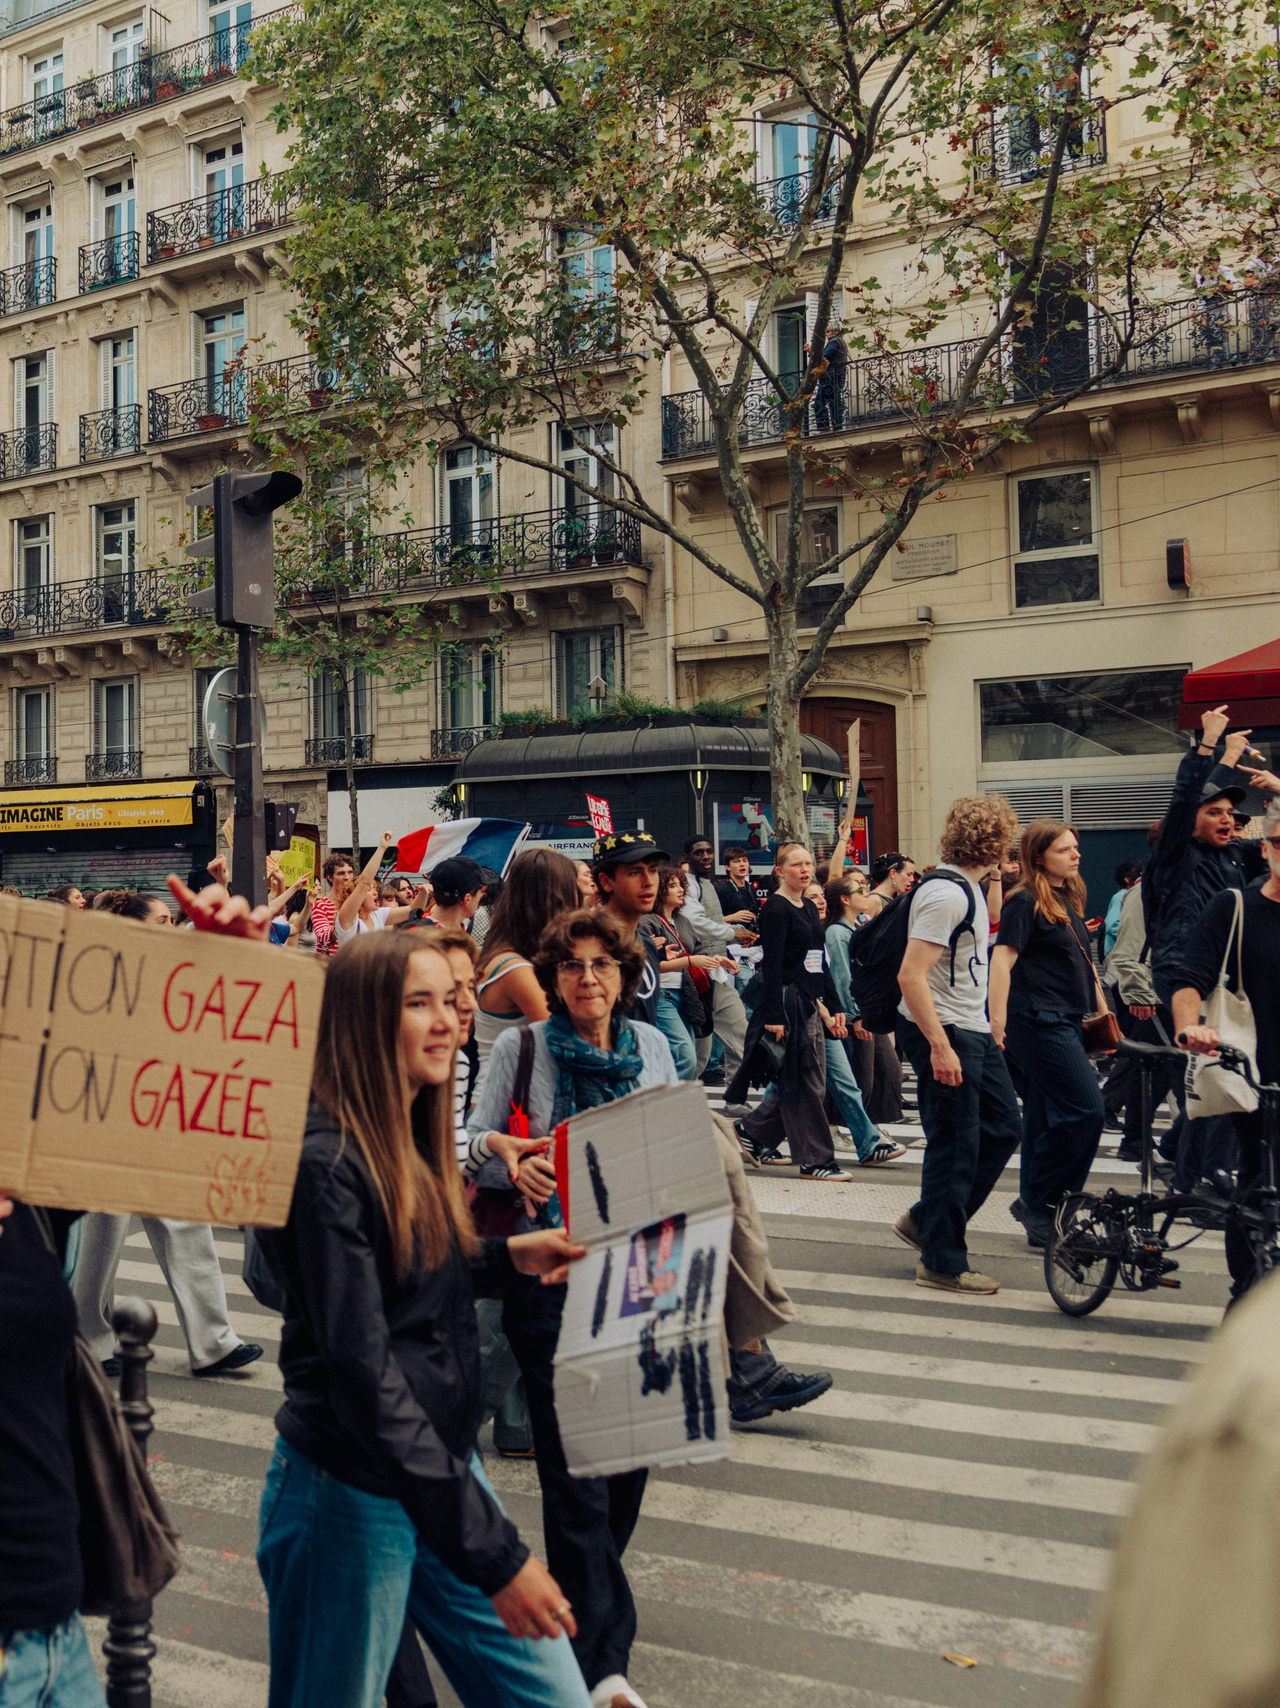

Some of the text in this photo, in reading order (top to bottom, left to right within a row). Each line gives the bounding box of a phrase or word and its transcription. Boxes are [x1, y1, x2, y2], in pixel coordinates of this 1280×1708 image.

[0, 807, 64, 824] IMAGINE
[66, 804, 104, 821] Paris
[148, 808, 165, 817] shop
[163, 962, 299, 1049] GAZA
[130, 1059, 272, 1140] GAZÉE
